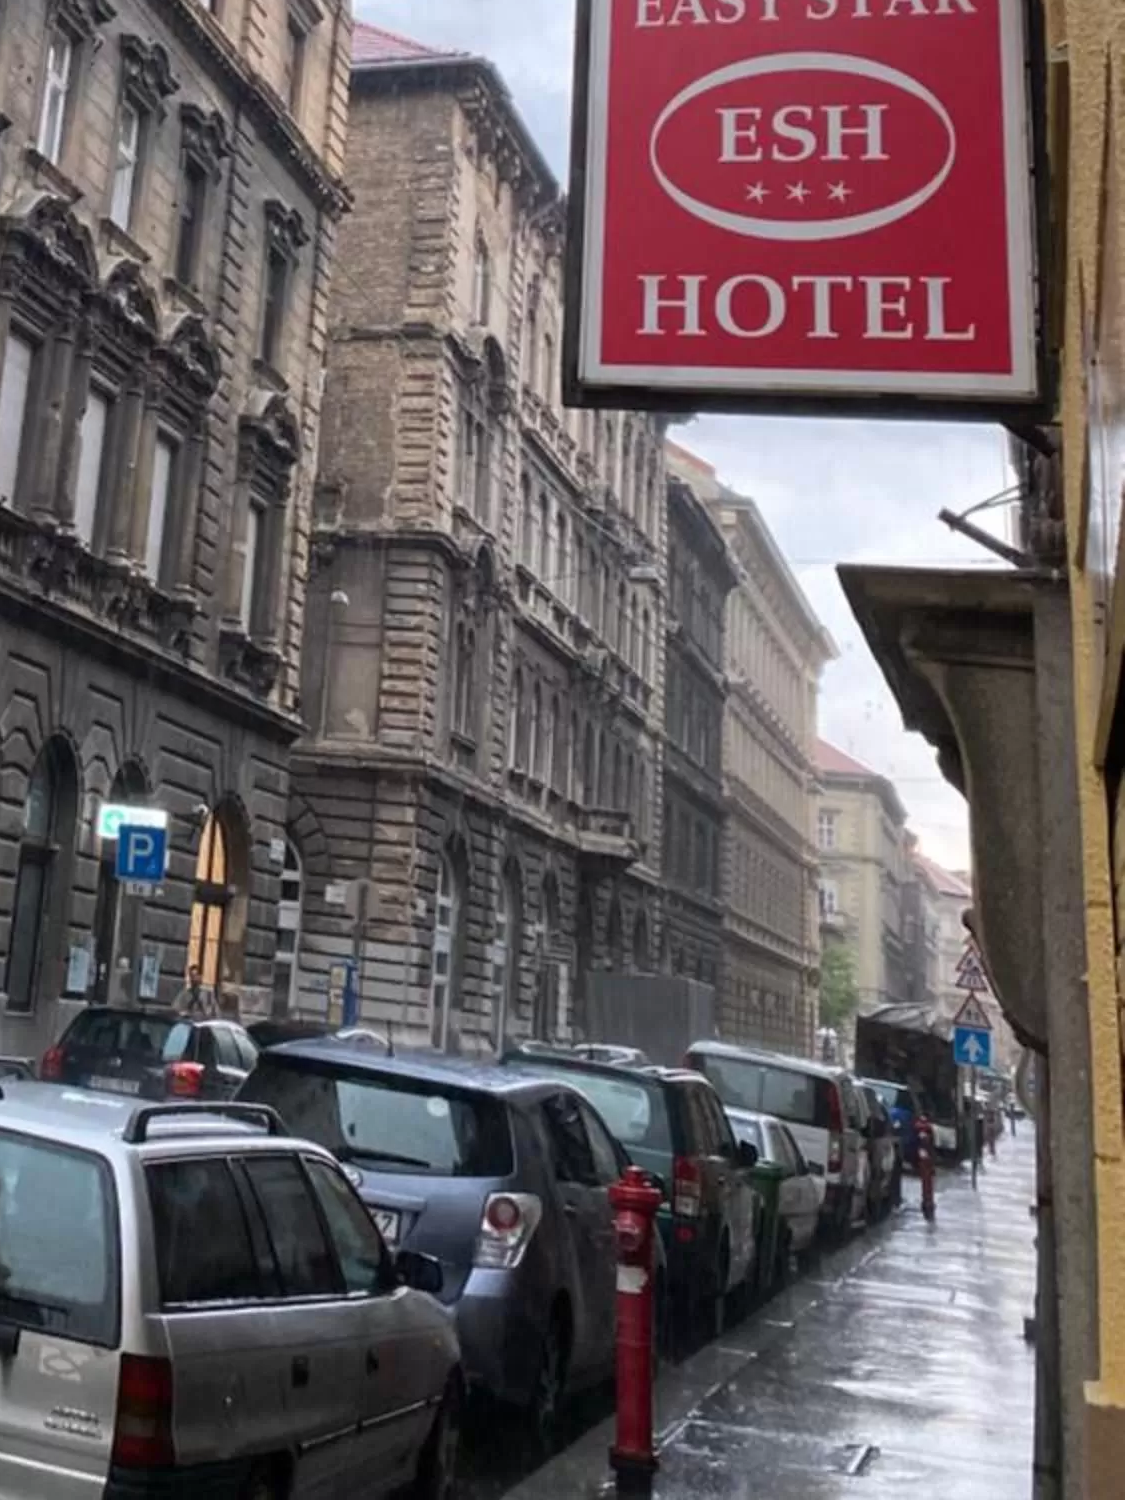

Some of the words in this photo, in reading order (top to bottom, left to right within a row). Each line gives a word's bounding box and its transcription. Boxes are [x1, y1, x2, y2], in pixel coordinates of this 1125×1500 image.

[717, 104, 890, 163] ESH
[637, 274, 976, 341] HOTEL
[127, 832, 155, 873] P
